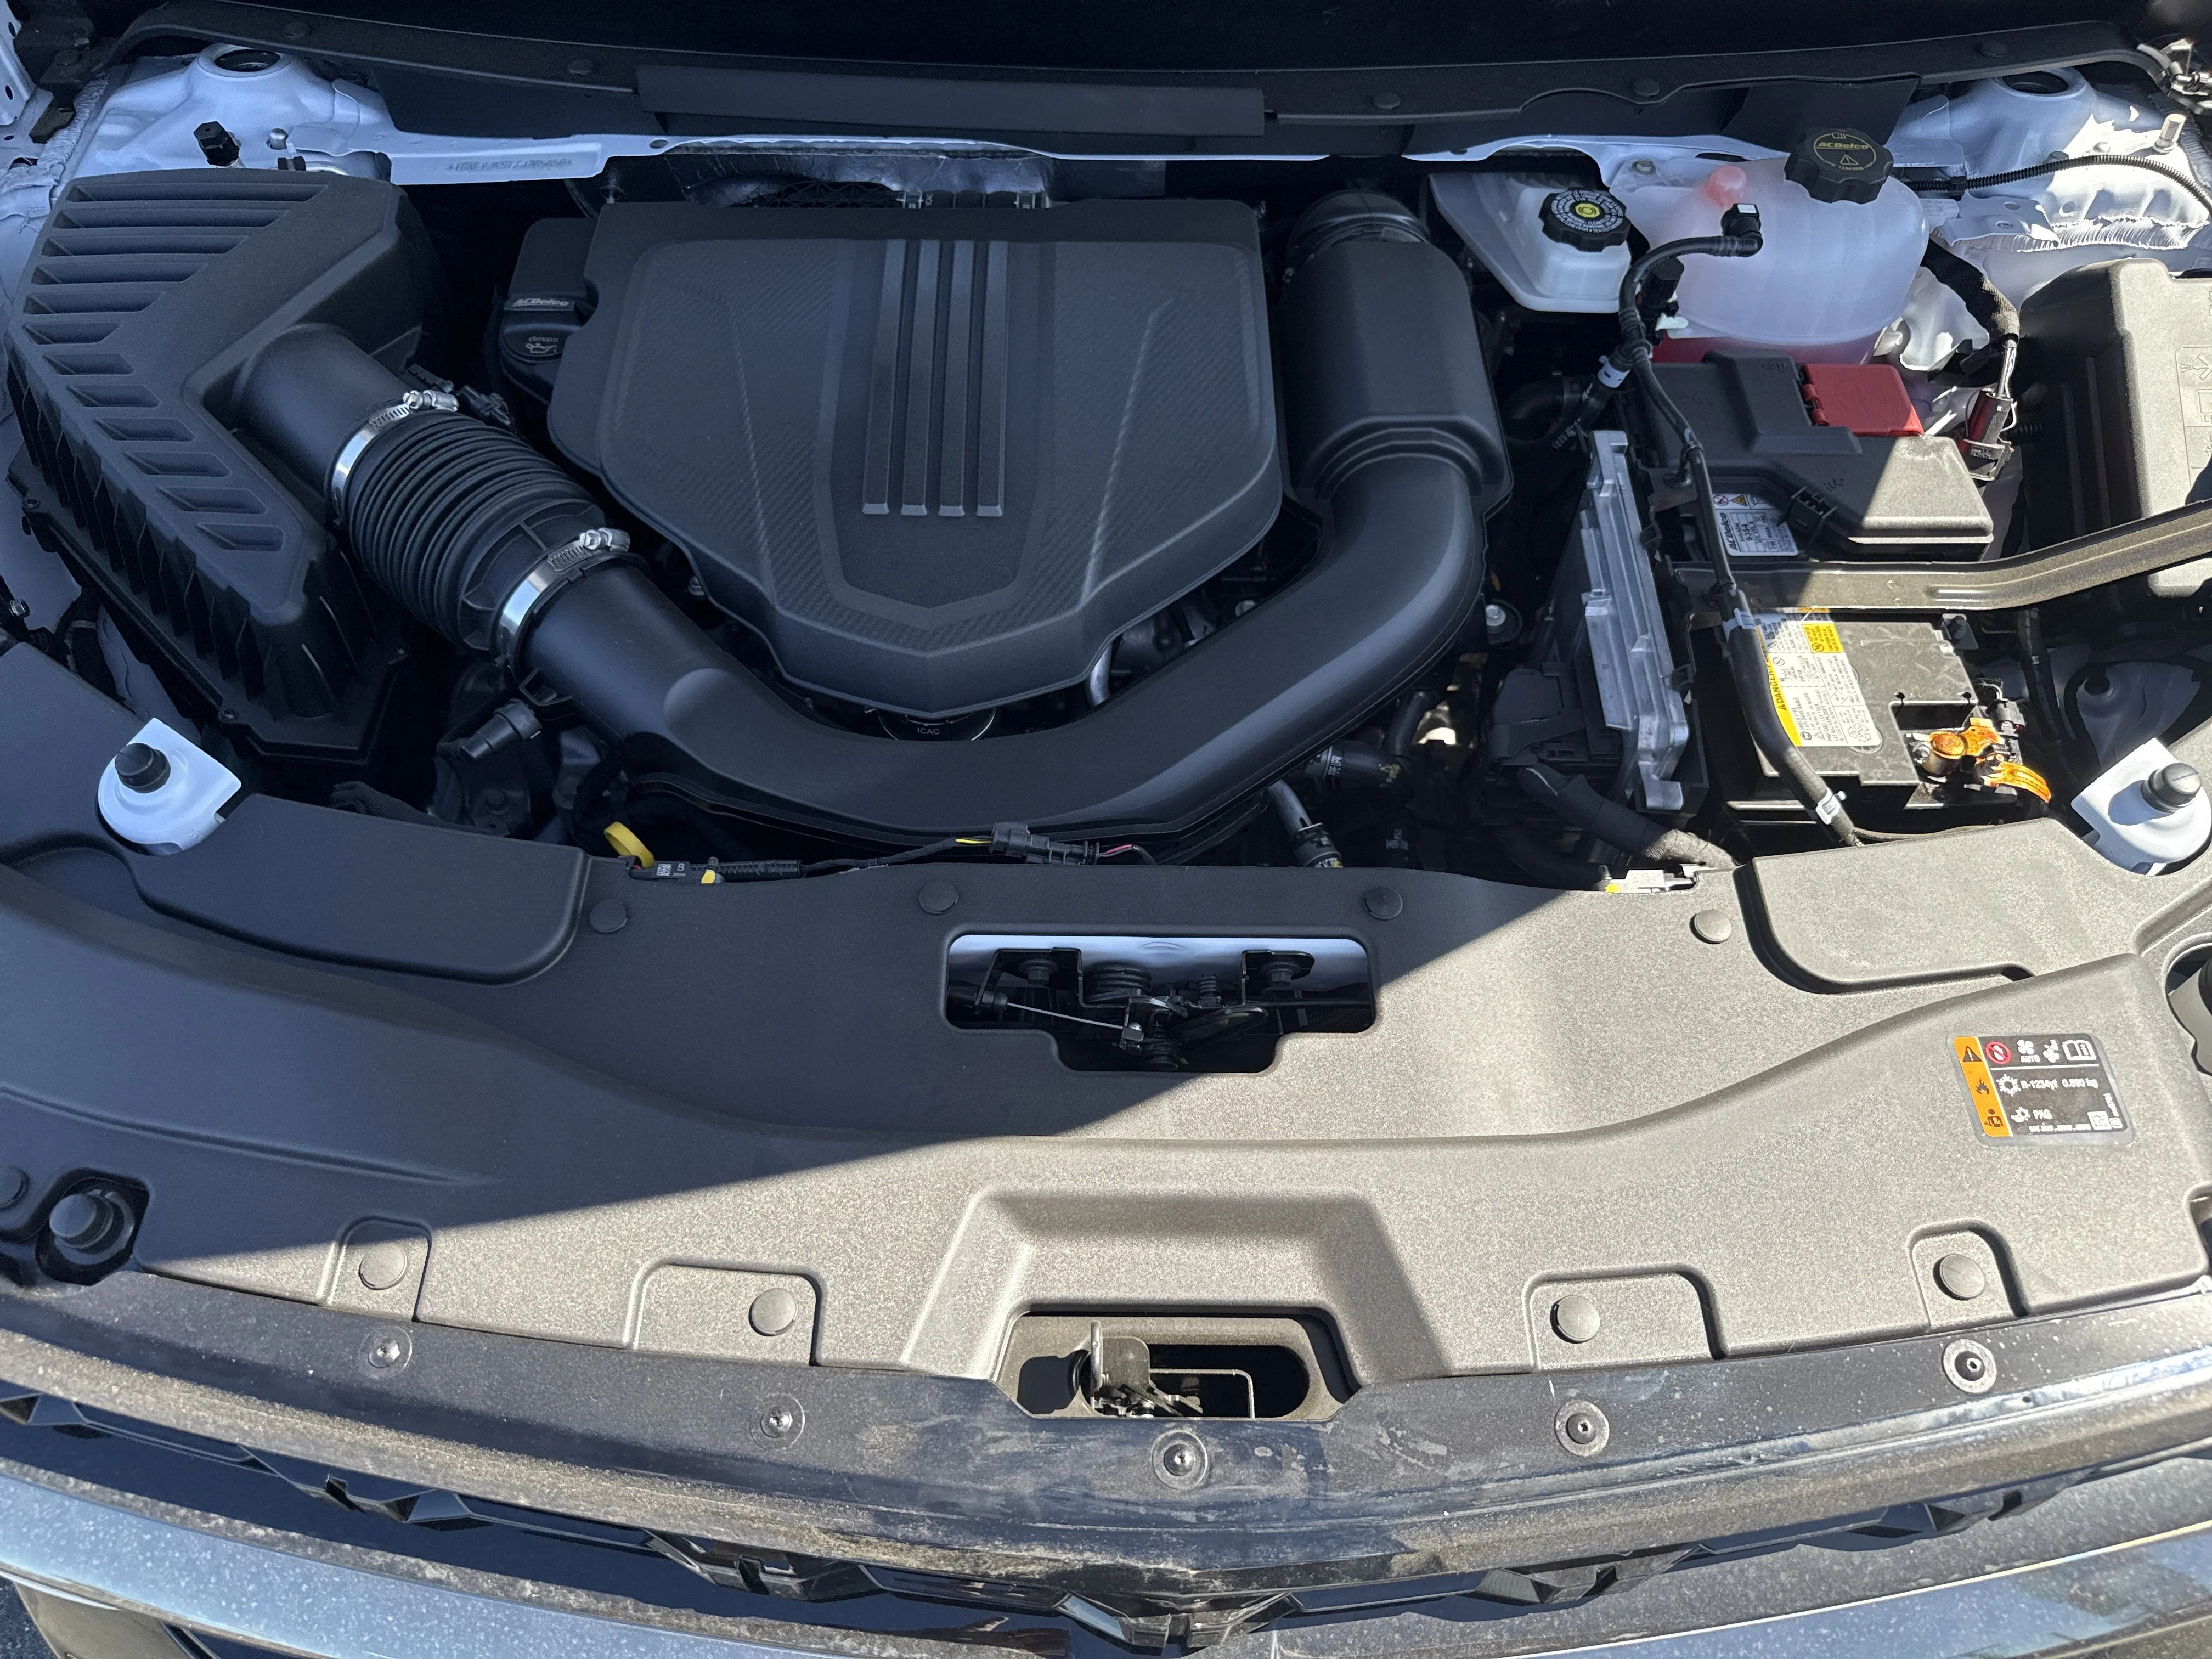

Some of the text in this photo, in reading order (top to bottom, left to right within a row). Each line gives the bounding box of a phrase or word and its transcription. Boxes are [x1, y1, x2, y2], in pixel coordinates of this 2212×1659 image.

[512, 298, 569, 307] ACDelco
[1719, 512, 1738, 551] ACDelco
[917, 727, 940, 735] ICAC
[676, 862, 685, 872] B
[2021, 1055, 2040, 1063] AUTO
[2020, 1079, 2058, 1091] R-1234yf
[2032, 1109, 2052, 1120] PAG
